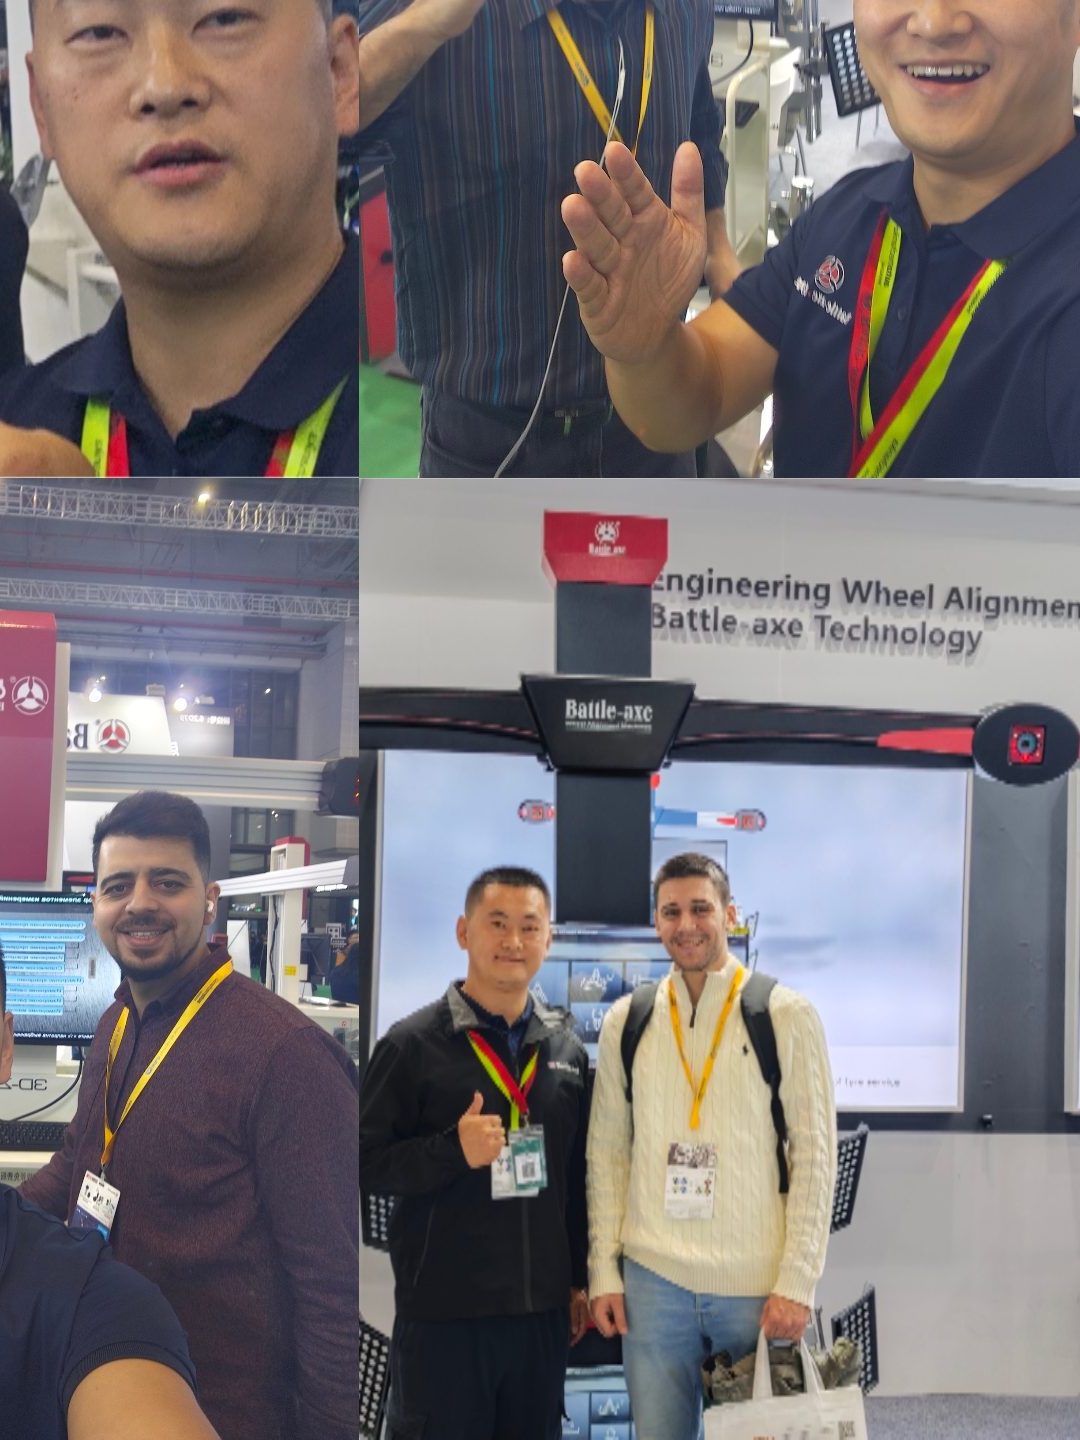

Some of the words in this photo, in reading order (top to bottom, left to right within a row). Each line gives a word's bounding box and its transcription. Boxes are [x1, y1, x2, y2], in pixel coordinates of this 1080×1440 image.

[842, 577, 934, 611] Wheel
[652, 603, 804, 639] Battle-axe
[814, 615, 983, 656] Technology
[565, 699, 653, 723] Battle-axe
